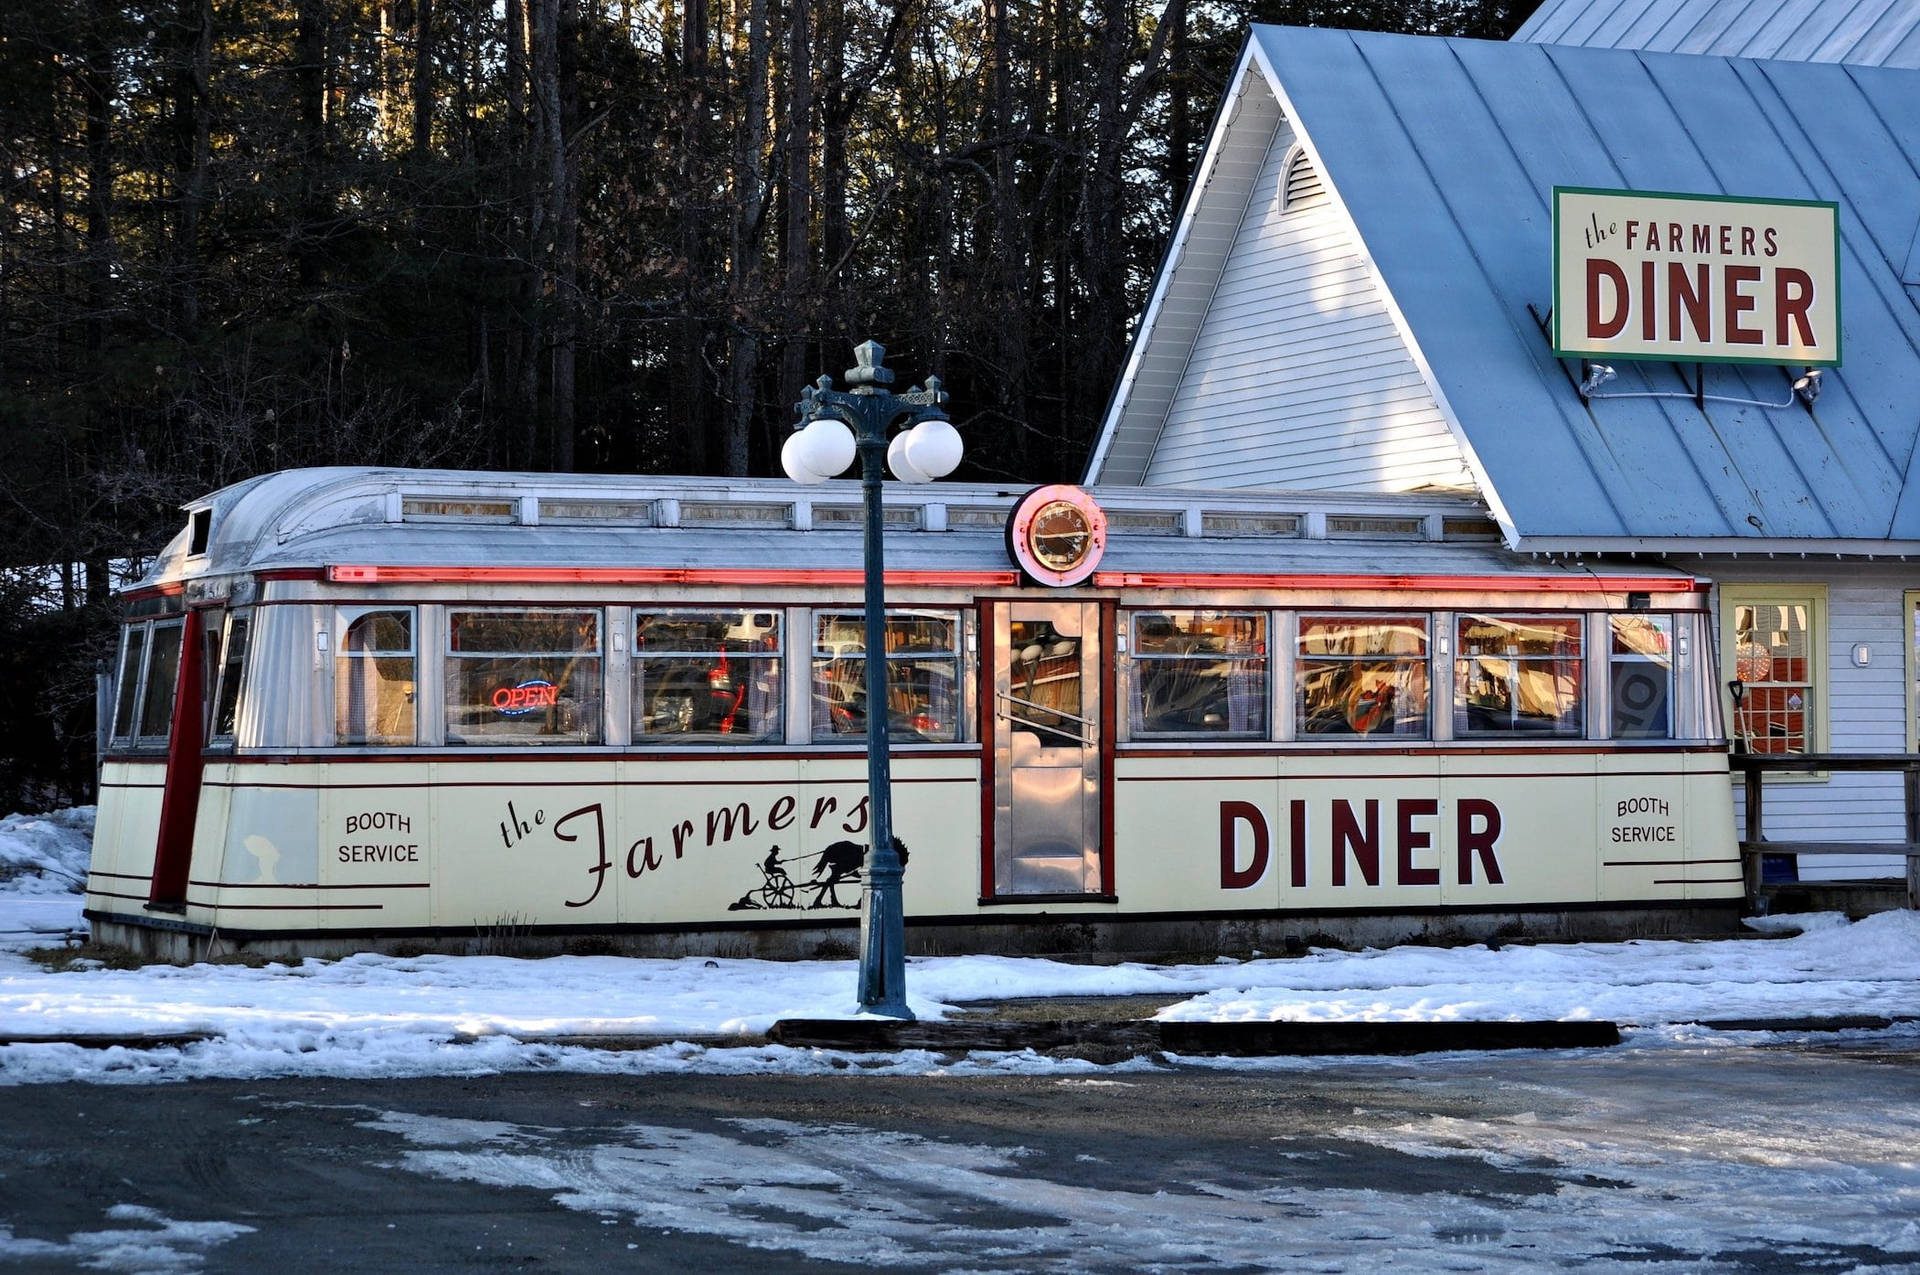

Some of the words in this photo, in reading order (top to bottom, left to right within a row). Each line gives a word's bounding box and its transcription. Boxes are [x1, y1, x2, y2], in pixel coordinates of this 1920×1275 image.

[1585, 212, 1618, 249] the
[1626, 220, 1778, 257] FARMERS
[1585, 258, 1818, 347] DINER
[493, 685, 558, 708] OPEN
[1617, 797, 1669, 817] BOOTH
[346, 811, 410, 835] BOOTH
[1611, 826, 1676, 842] SERVICE
[338, 844, 419, 863] SERVICE
[500, 800, 546, 849] the
[553, 795, 870, 907] Farmers
[1220, 798, 1505, 890] DINER
